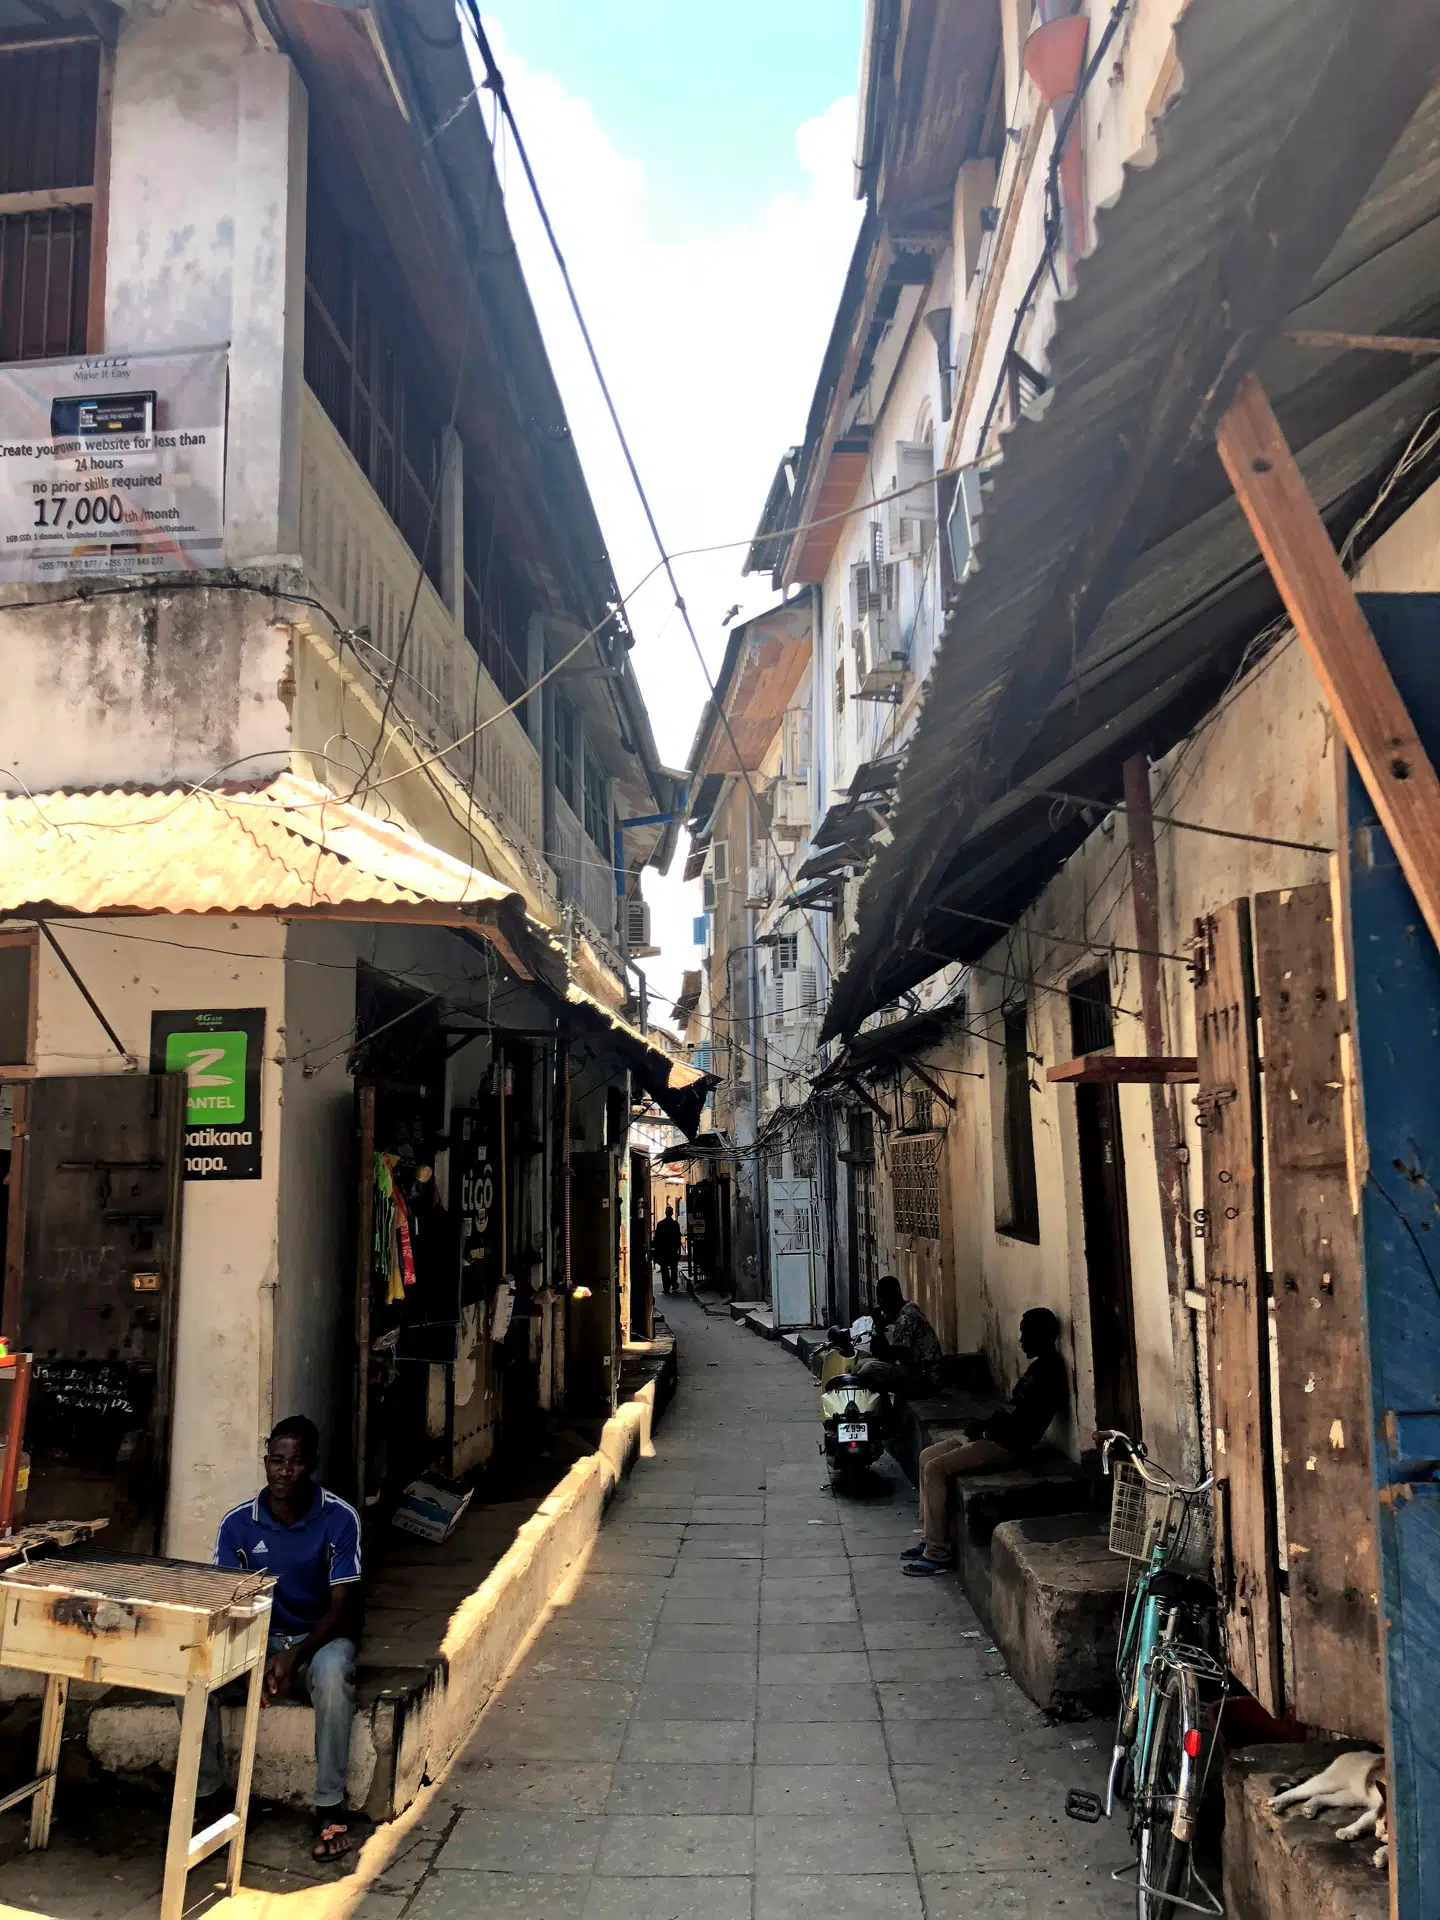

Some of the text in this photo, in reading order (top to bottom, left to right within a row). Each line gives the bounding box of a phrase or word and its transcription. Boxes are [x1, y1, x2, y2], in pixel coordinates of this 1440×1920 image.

[74, 370, 99, 380] Make
[111, 369, 132, 380] Easy
[85, 437, 130, 451] website
[134, 436, 151, 449] for
[154, 435, 177, 447] less
[179, 433, 206, 446] than
[75, 457, 123, 472] 24 hours
[33, 473, 162, 496] no prior skills required
[195, 1014, 212, 1022] 4G
[186, 1096, 235, 1109] ANTEL
